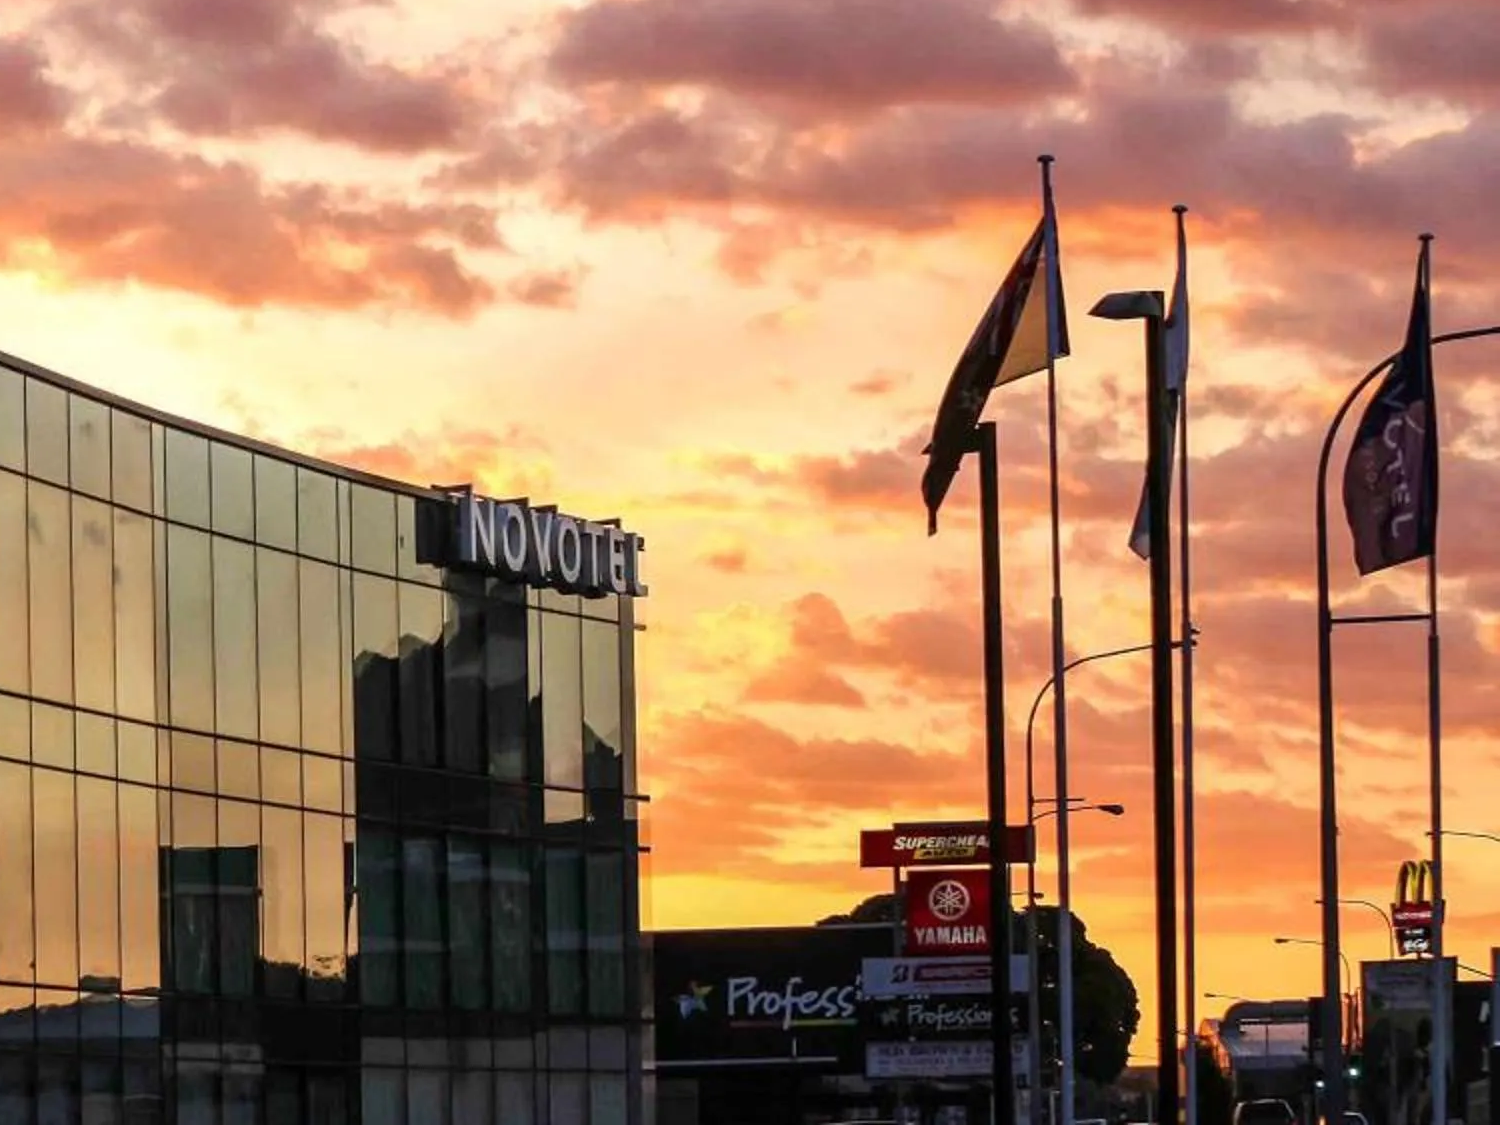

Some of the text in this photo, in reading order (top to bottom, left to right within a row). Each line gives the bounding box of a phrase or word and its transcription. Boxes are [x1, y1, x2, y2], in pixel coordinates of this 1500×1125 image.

[469, 494, 648, 596] NOVOTEL
[892, 834, 990, 851] SUPERCHEA
[913, 926, 987, 946] YAMAHA
